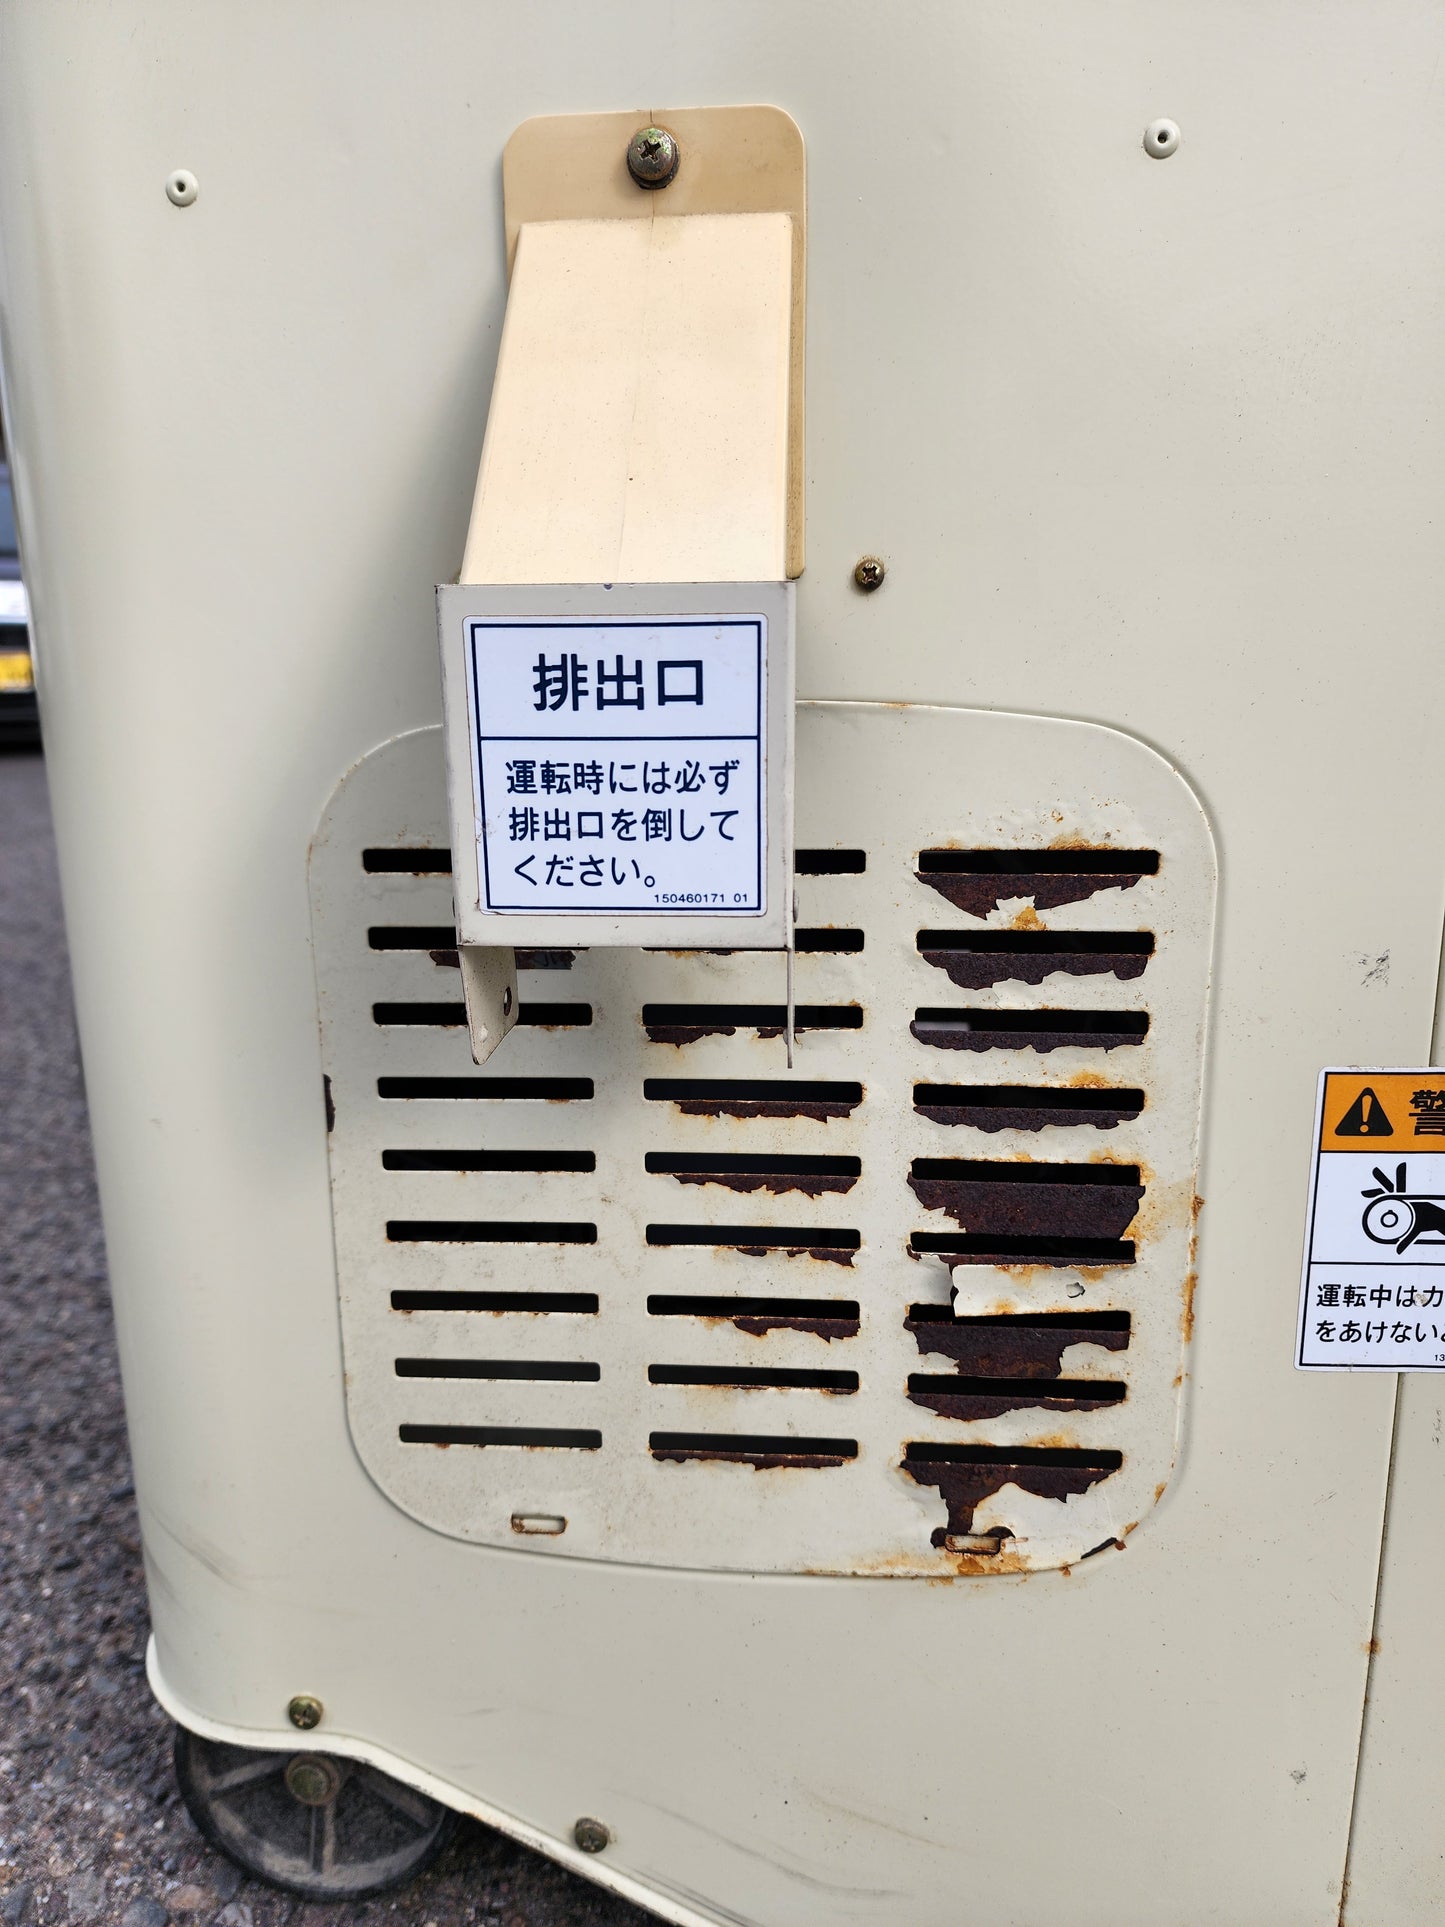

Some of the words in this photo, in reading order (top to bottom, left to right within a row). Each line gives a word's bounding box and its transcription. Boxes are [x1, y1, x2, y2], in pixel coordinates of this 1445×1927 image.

[532, 653, 704, 712] 排出口
[505, 759, 741, 796] 運転時には必ず
[508, 806, 740, 842] 排出口を倒して
[514, 854, 656, 888] ください。
[654, 893, 725, 904] 150460171
[733, 893, 748, 903] 01
[1315, 1319, 1445, 1344] をあけない
